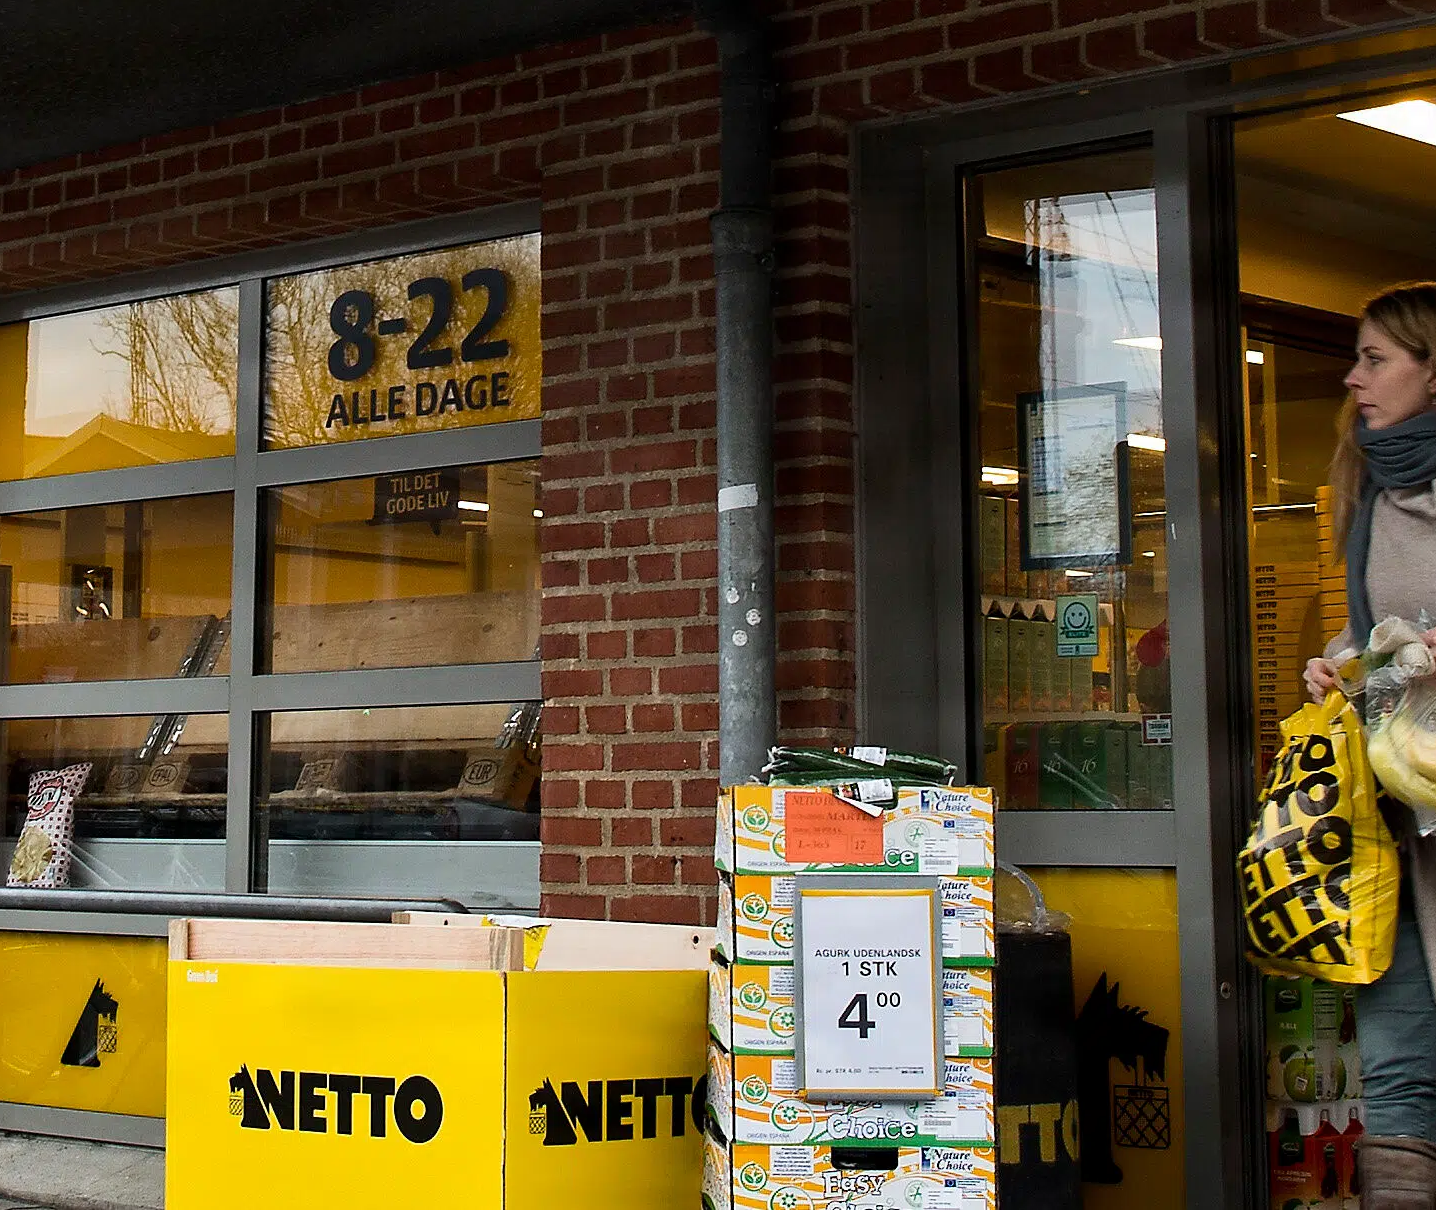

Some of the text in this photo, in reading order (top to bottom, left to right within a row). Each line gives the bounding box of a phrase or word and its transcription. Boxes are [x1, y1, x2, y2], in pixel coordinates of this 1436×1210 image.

[327, 268, 511, 382] 8-22
[325, 371, 510, 428] ALLE DAGE
[391, 472, 441, 493] TIL DET
[386, 491, 449, 514] GODE LIV
[468, 763, 492, 781] EUR
[933, 791, 969, 802] Nature
[935, 802, 972, 812] Choice
[945, 892, 972, 900] hoice
[814, 949, 921, 958] AGURK UDENLANDSK
[842, 961, 898, 976] 1 STK
[943, 981, 970, 990] hoice
[838, 992, 901, 1039] 4 00
[945, 1074, 973, 1083] hoice
[241, 1068, 444, 1144] NETTO
[934, 1150, 971, 1161] Nature
[937, 1160, 973, 1171] Choice
[822, 1170, 886, 1199] Easy
